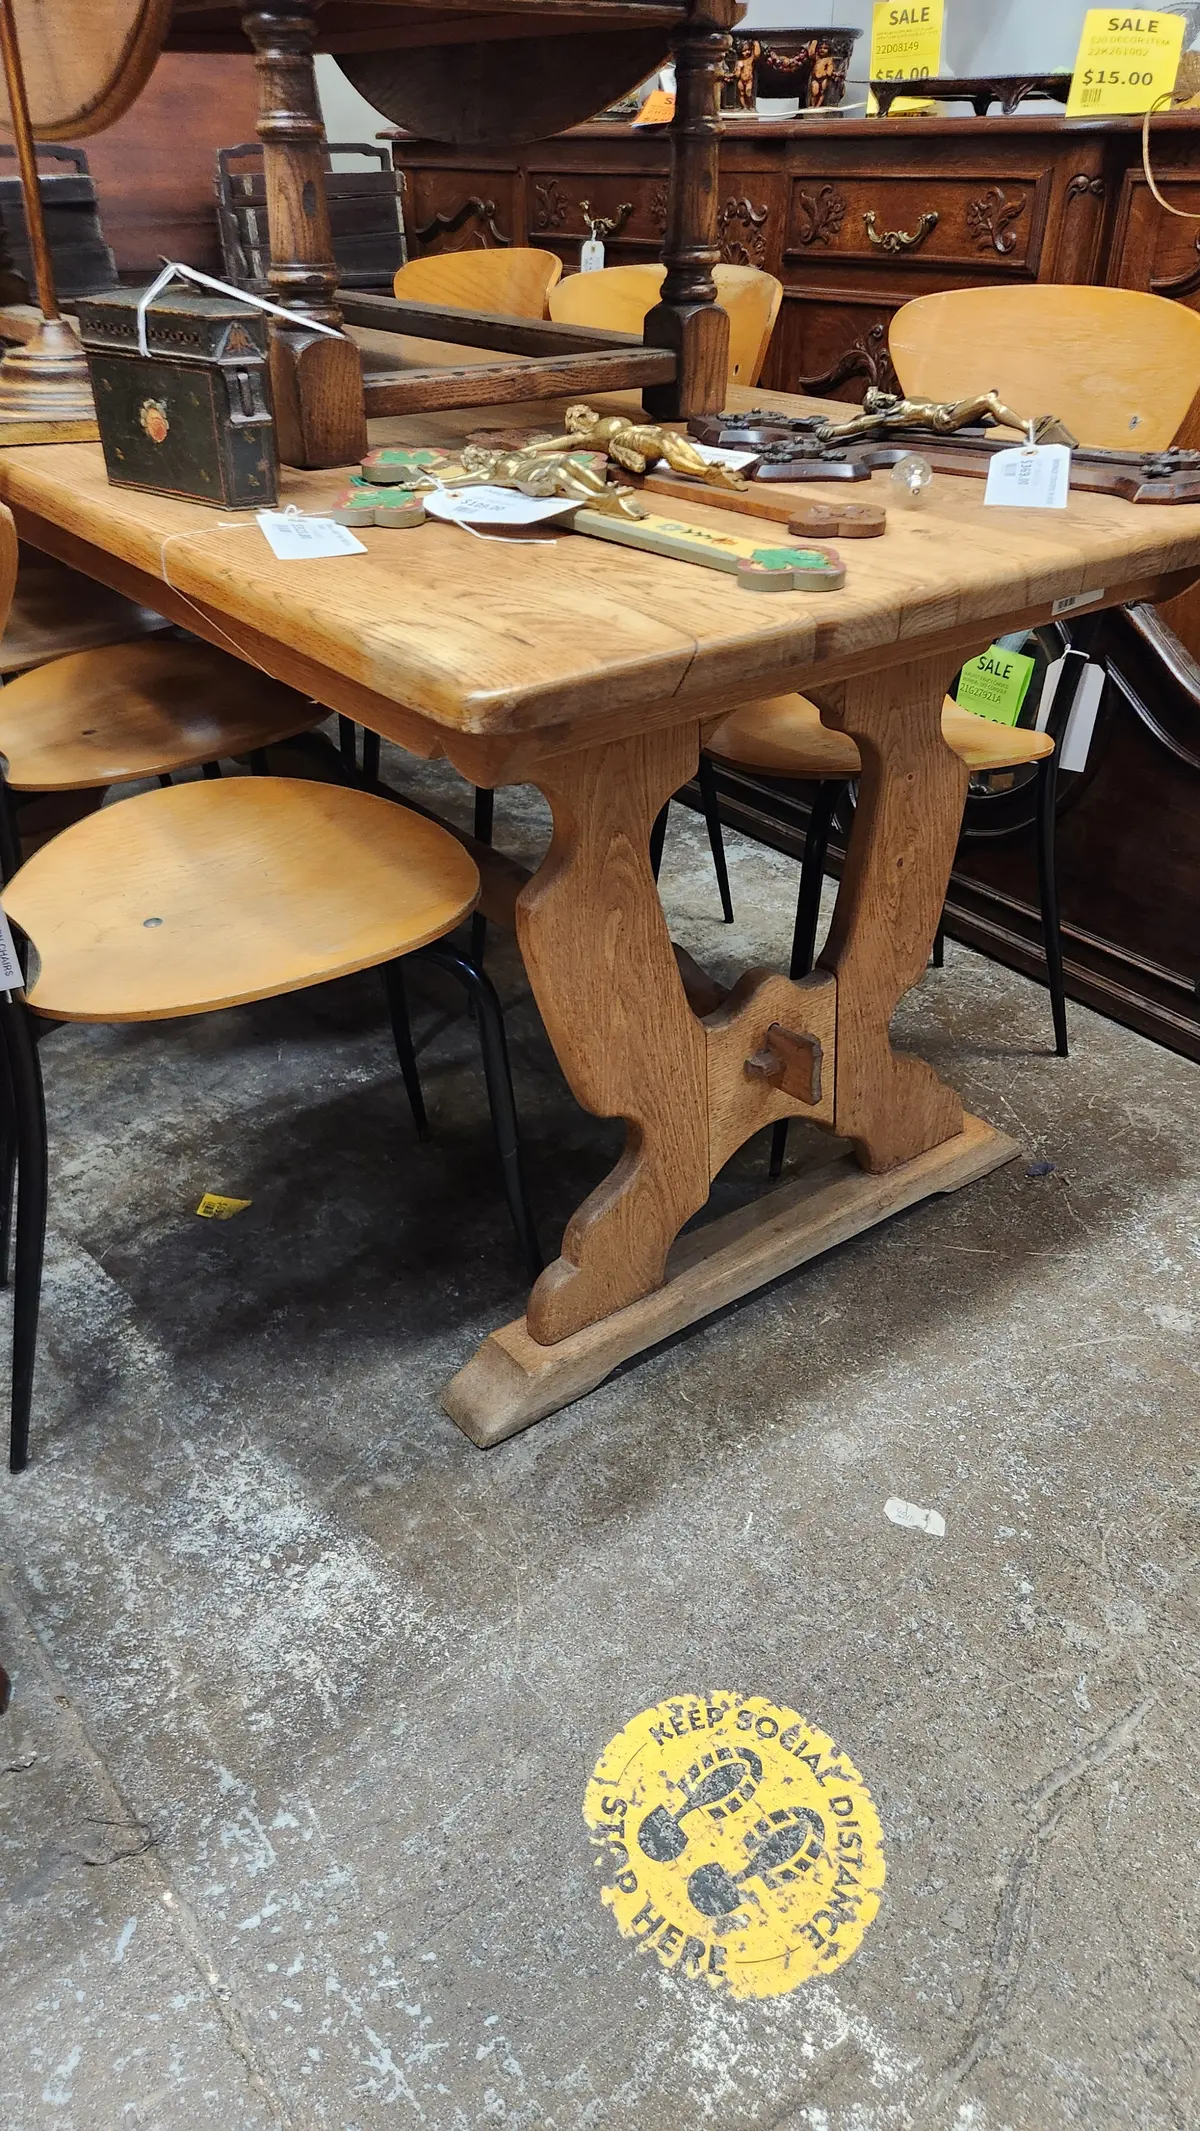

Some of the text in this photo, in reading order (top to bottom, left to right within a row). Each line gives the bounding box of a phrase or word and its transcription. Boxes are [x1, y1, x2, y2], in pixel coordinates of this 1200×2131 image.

[888, 6, 931, 26] SALE
[1107, 17, 1160, 33] SALE
[875, 41, 920, 55] 22D08149
[1109, 36, 1144, 45] DECOR
[875, 65, 930, 81] $5400
[1081, 68, 1153, 86] $15.00
[976, 655, 1014, 680] SALE
[960, 682, 1001, 704] 21G27921A
[0, 943, 14, 977] CHAIRS
[648, 1707, 865, 1951] KEEP SOCIAL DISTANCE
[599, 1794, 728, 1977] STOP HERE
